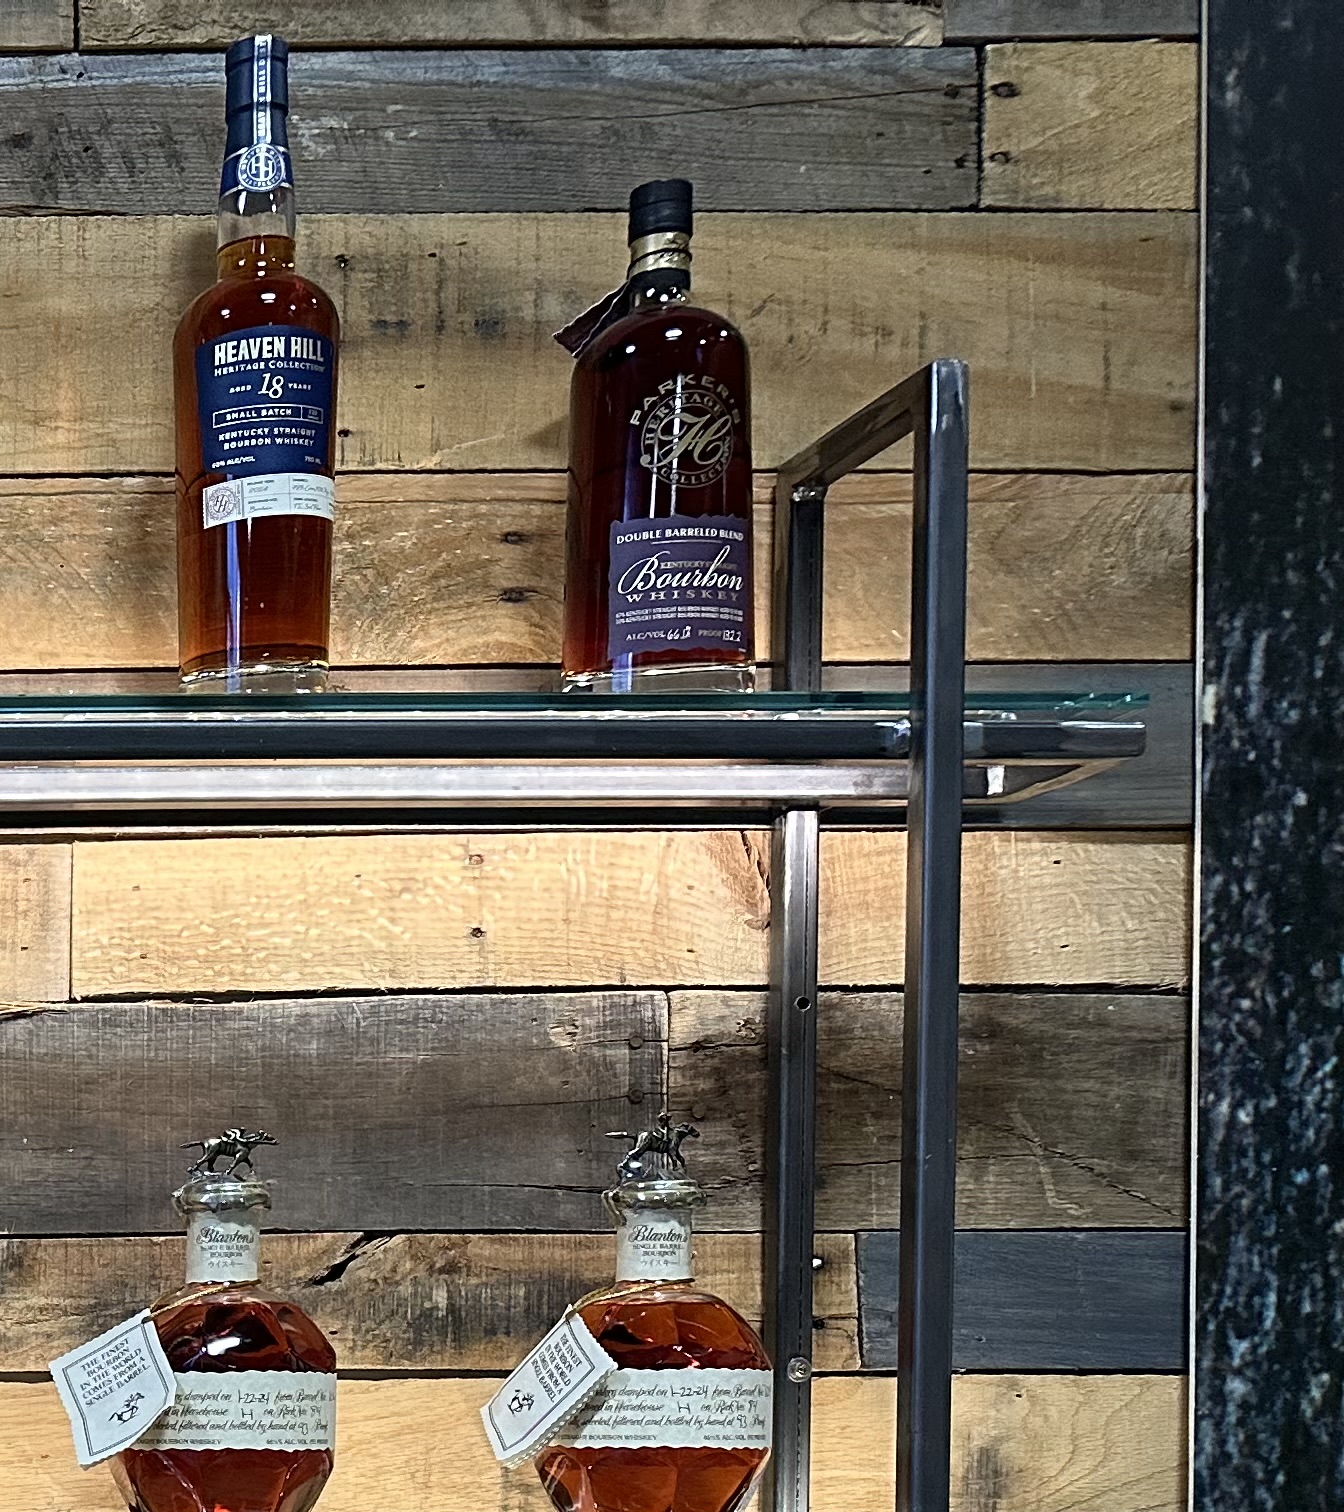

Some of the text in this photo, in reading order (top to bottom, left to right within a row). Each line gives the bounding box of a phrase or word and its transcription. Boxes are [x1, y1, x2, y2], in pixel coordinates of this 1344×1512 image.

[214, 336, 324, 366] HEAVEN HILL
[214, 360, 326, 377] HERITAGE COLLECTION
[257, 372, 284, 399] 18
[629, 373, 741, 426] PARKER'S
[225, 408, 292, 420] SMALL BATCH
[218, 427, 316, 441] KENTUCKY STRAIGHT
[223, 437, 314, 450] BOURBON WHISKEY
[616, 527, 744, 544] DOUBLE BARRELED BLEND
[617, 545, 744, 594] Bourbon
[626, 589, 739, 603] WHISKEY
[80, 1337, 129, 1371] THE FINEST
[87, 1347, 130, 1377] BOURBON
[92, 1369, 111, 1383] THE
[112, 1348, 141, 1371] WORLD
[82, 1378, 113, 1399] COMES
[113, 1361, 137, 1380] FROM
[671, 1386, 708, 1398] 1-22-24
[85, 1386, 115, 1408] SINGLE
